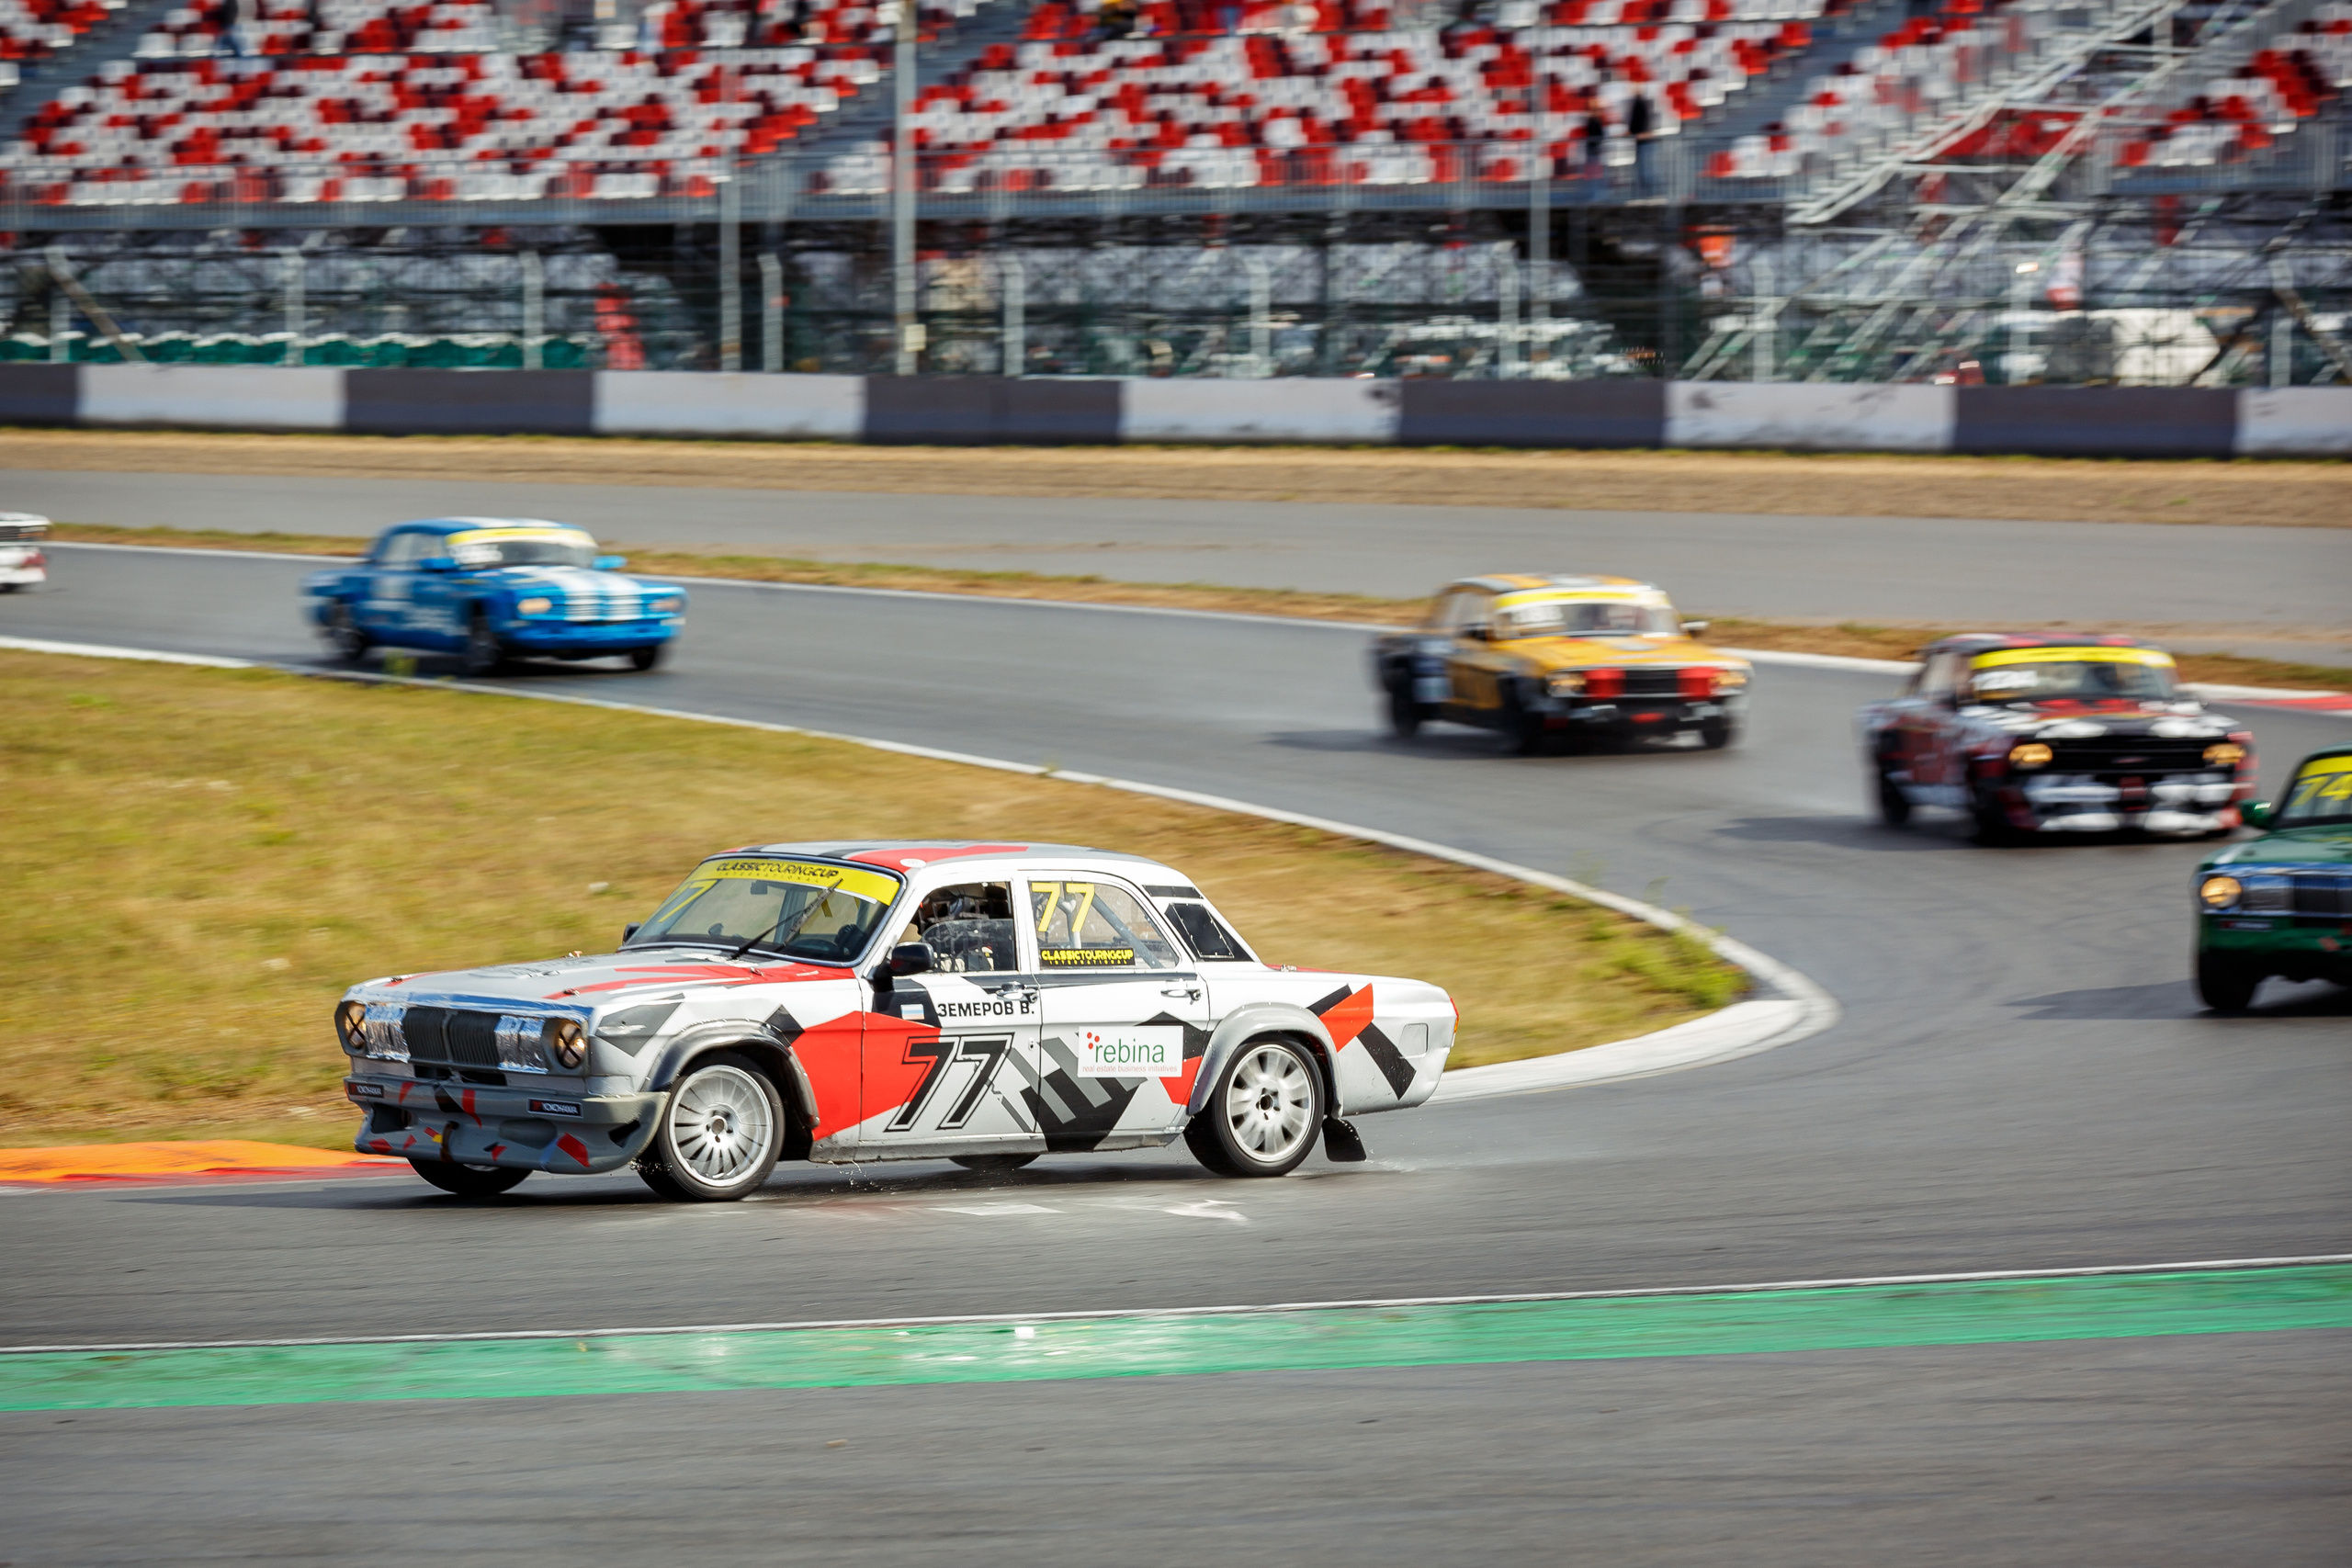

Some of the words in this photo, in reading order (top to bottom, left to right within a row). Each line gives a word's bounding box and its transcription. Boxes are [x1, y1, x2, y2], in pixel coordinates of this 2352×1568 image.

[716, 862, 840, 879] CLASSICTOURINGCUP
[1031, 882, 1095, 932] 77
[1041, 950, 1134, 961] CLASSICTOURINGCUP
[937, 1001, 1014, 1017] ЗЕМЕРОВ
[1020, 1000, 1035, 1014] В.
[1095, 1038, 1164, 1063] rebina
[1148, 1065, 1177, 1073] initiatives
[882, 1032, 1015, 1133] 77
